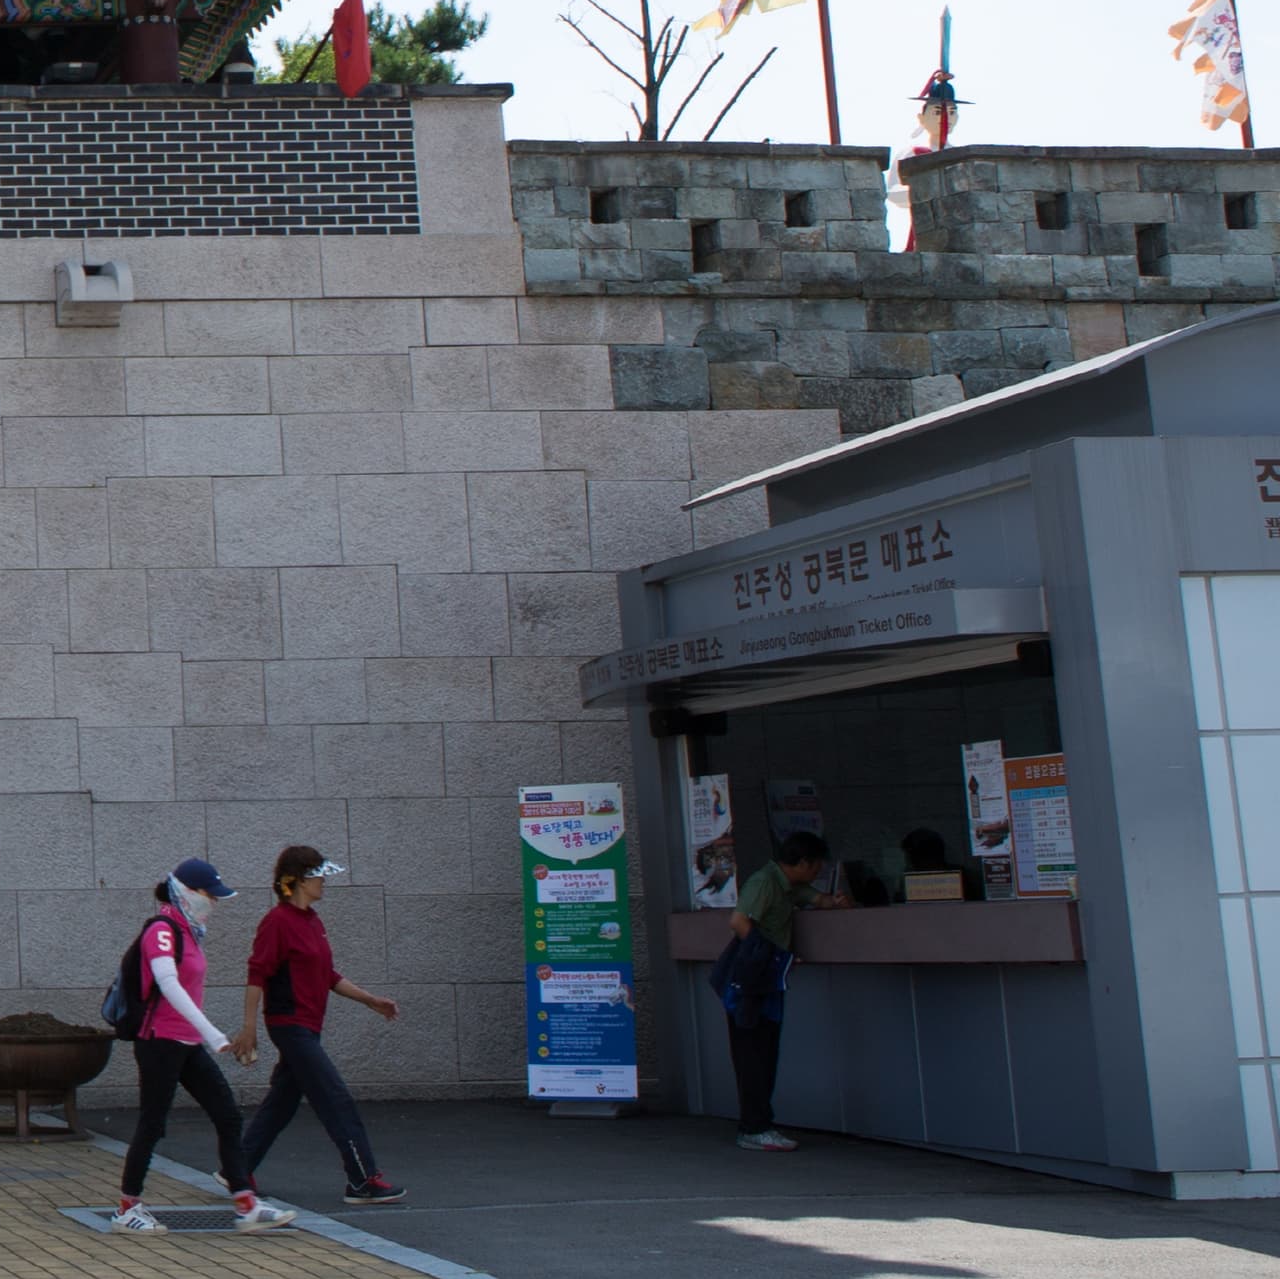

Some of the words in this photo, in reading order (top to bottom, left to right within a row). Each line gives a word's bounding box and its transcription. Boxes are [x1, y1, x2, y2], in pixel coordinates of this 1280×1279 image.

[733, 560, 792, 611] 진주성
[803, 540, 869, 595] 공북문
[880, 519, 953, 573] 매표소
[787, 624, 855, 648] Gongbukmun
[857, 617, 893, 635] Ticket
[895, 611, 932, 629] Office
[618, 651, 644, 681] 진주성
[646, 643, 681, 674] 공북문
[682, 636, 724, 665] 매표소
